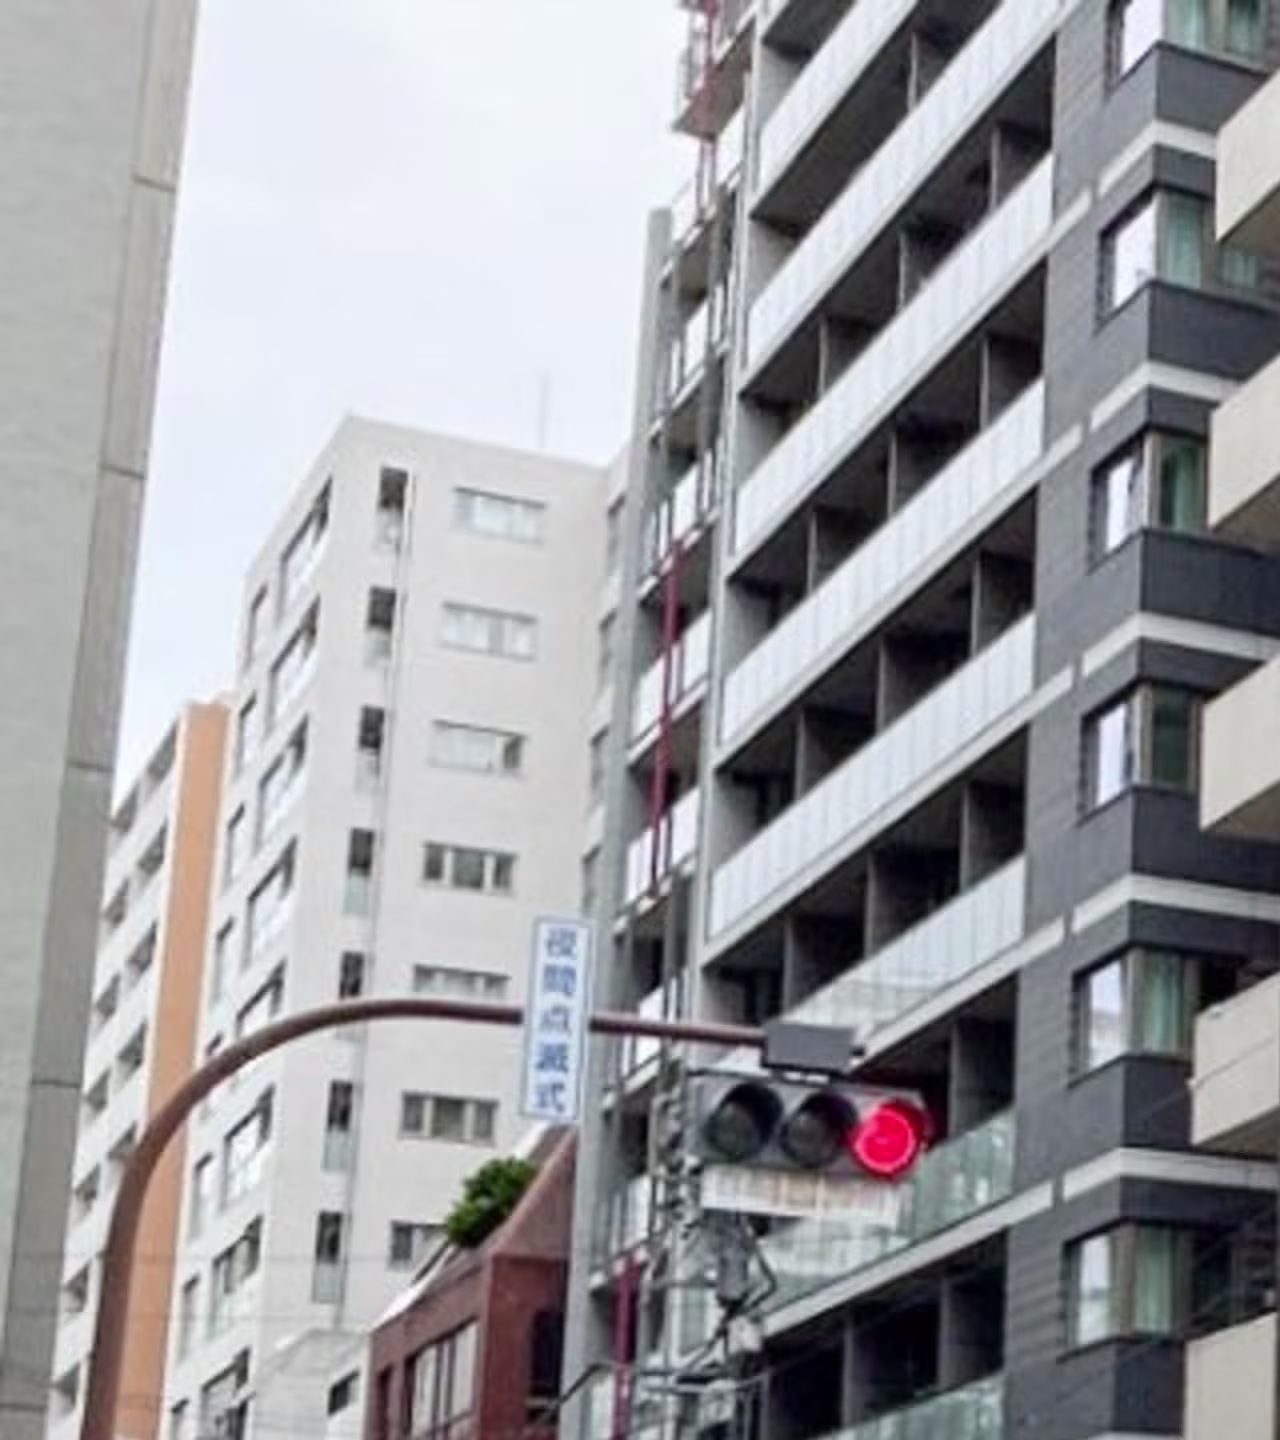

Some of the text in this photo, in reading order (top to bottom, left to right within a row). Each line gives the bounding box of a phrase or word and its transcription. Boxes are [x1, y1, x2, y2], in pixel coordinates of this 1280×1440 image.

[535, 927, 578, 1114] 夜間点滅式
